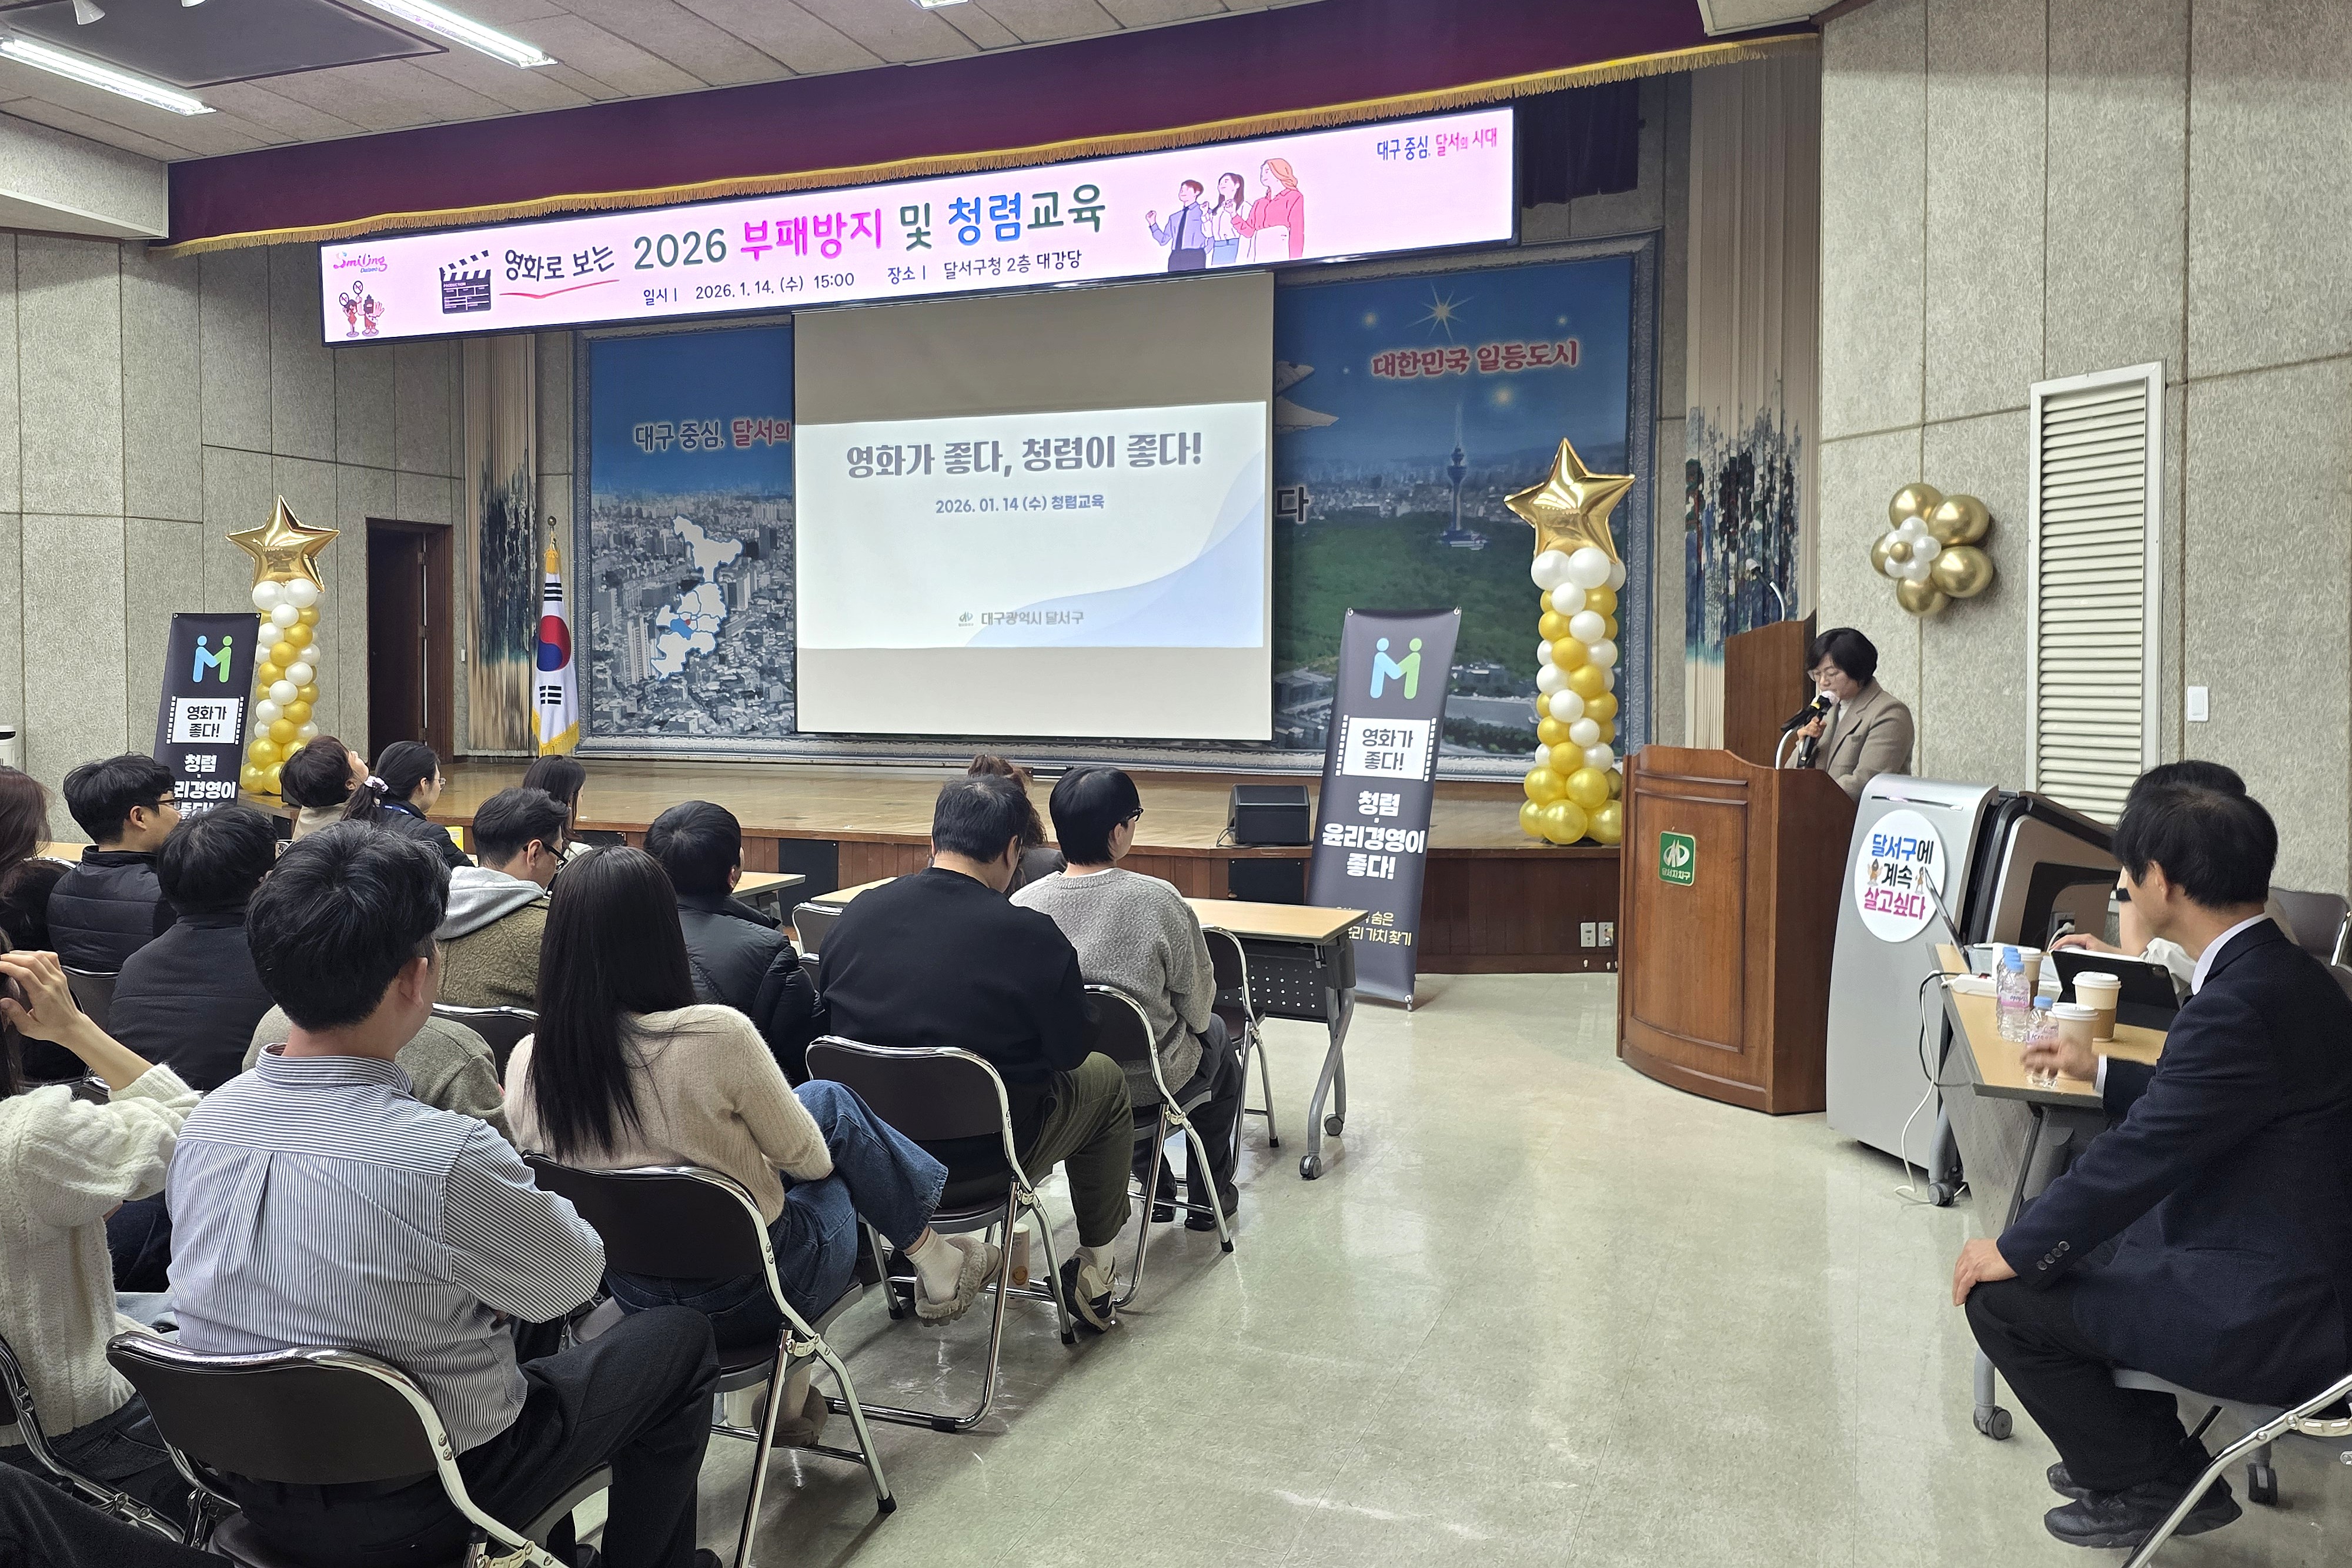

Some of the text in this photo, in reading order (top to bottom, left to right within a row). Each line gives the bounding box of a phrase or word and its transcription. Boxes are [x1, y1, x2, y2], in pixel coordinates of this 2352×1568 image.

[1377, 139, 1401, 161] 대구
[1436, 132, 1468, 156] 달서의
[1472, 128, 1497, 149] 시대
[505, 183, 1106, 282] 영화로 보는 2026 부패방지 및 청렴교육
[333, 251, 388, 272] Smiling
[887, 266, 916, 285] 장소
[944, 257, 1001, 280] 달서구청
[1007, 253, 1031, 273] 2층
[1037, 249, 1083, 270] 대강당
[643, 287, 668, 306] 일시
[696, 286, 736, 300] 2026.
[780, 276, 804, 293] (수)
[814, 273, 855, 289] 15:00
[1372, 340, 1578, 377] 대한민국 일등도시
[636, 419, 790, 452] 대구 중심, 달서의
[847, 432, 1202, 479] 영화가 좋다, 청렴이 좋다!
[936, 494, 1105, 513] 2026. 01. 14 (수) 청렴교육
[981, 611, 1084, 626] 대구광역시 달서구
[186, 706, 227, 721] 영화가
[189, 723, 220, 738] 좋다!
[1362, 728, 1414, 748] 영화가
[184, 754, 218, 773] 청렴
[1364, 751, 1404, 771] 좋다!
[173, 781, 236, 799] 리경영이
[1358, 790, 1401, 817] 청렴
[1322, 823, 1426, 854] 윤리경영이
[1871, 834, 1935, 865] 달서구에
[1346, 852, 1396, 880] 좋다!
[1881, 862, 1913, 890] 계속
[1864, 887, 1926, 920] 살고싶다
[1366, 928, 1388, 943] 가치
[1388, 930, 1412, 947] 찾기
